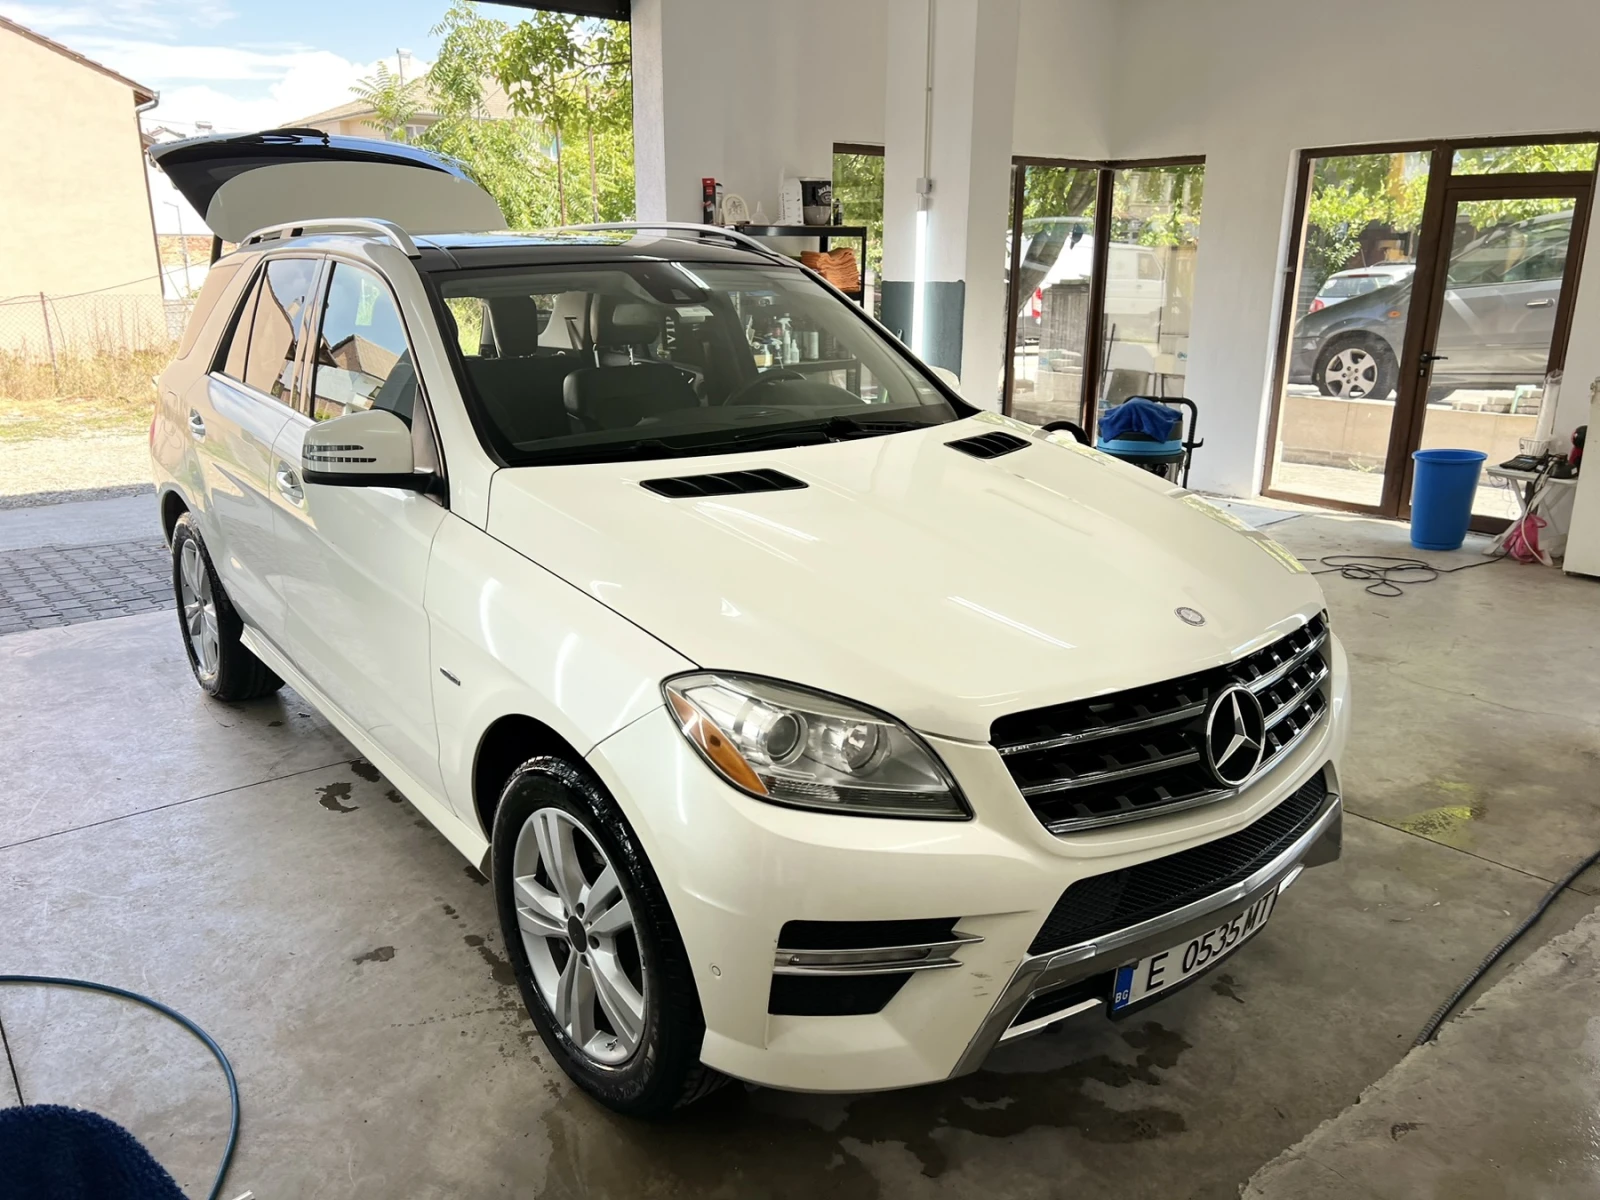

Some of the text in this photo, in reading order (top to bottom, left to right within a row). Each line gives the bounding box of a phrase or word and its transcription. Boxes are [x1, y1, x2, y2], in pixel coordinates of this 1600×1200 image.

[1146, 889, 1275, 992] E 0535 MT
[1115, 989, 1129, 1004] BG
